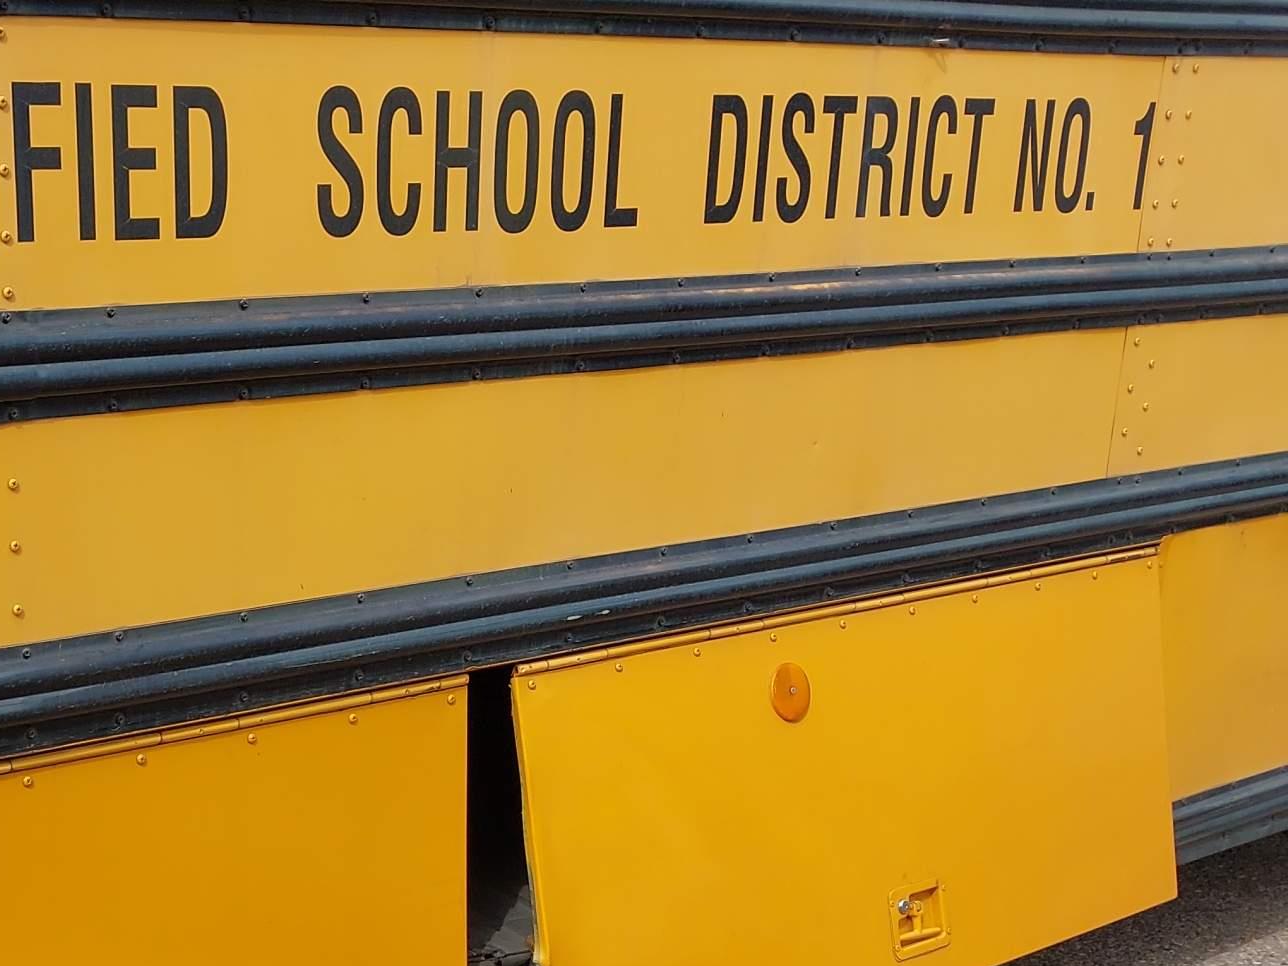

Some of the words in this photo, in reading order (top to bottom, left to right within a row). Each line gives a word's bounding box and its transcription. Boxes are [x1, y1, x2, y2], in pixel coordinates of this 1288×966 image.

[316, 84, 638, 238] SCHOOL
[703, 91, 997, 225] DISTRICT
[1012, 96, 1096, 213] NO.
[1132, 101, 1158, 211] 1
